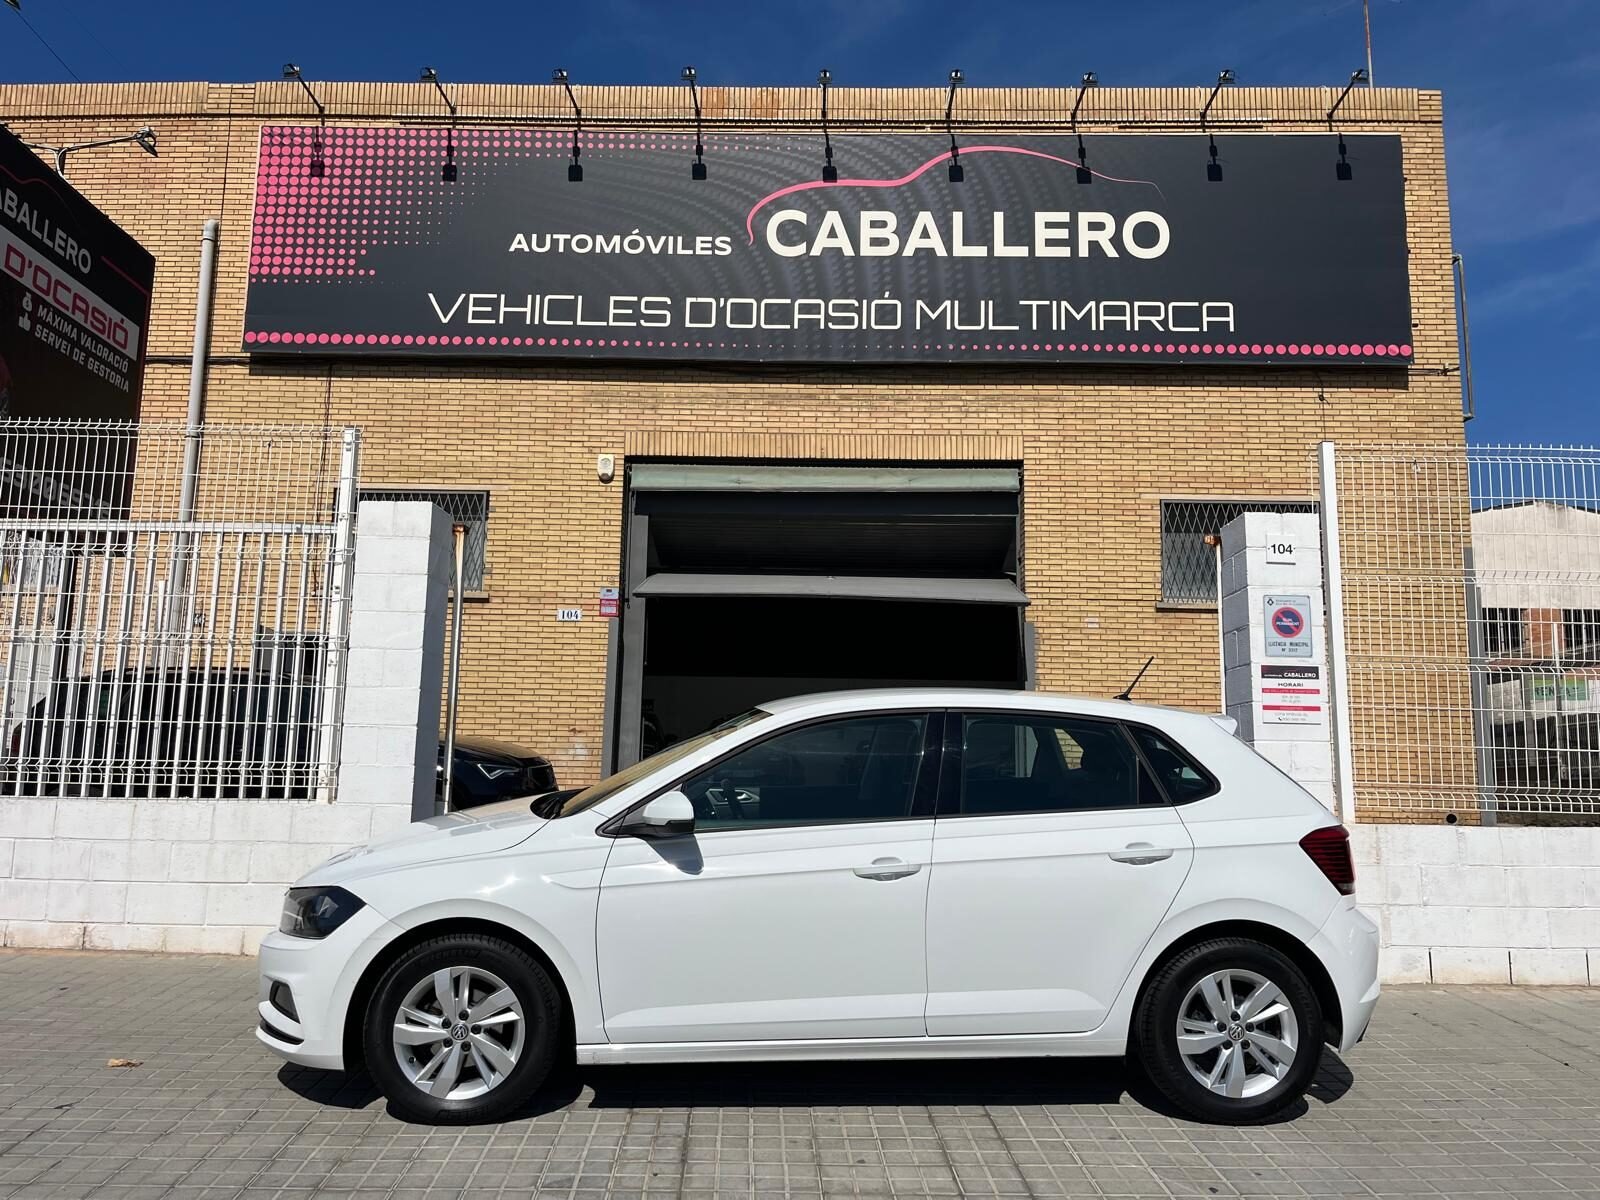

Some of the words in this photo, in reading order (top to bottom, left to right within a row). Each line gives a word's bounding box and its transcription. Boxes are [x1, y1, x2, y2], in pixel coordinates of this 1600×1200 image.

[0, 188, 92, 275] BALLERO
[509, 228, 732, 256] AUTOMÓVILES
[766, 209, 1170, 260] CABALLERO
[4, 243, 129, 350] D'OCASIÓ
[428, 292, 671, 328] VEHICLES
[684, 291, 902, 330] D'OCASIÓ
[915, 299, 1235, 333] MULTIMARCA
[34, 323, 72, 357] SERVEI
[72, 347, 85, 366] DE
[87, 355, 130, 393] GESTORIA
[80, 332, 129, 374] VALORACIÓ
[1270, 543, 1293, 555] 104
[562, 610, 578, 620] 104
